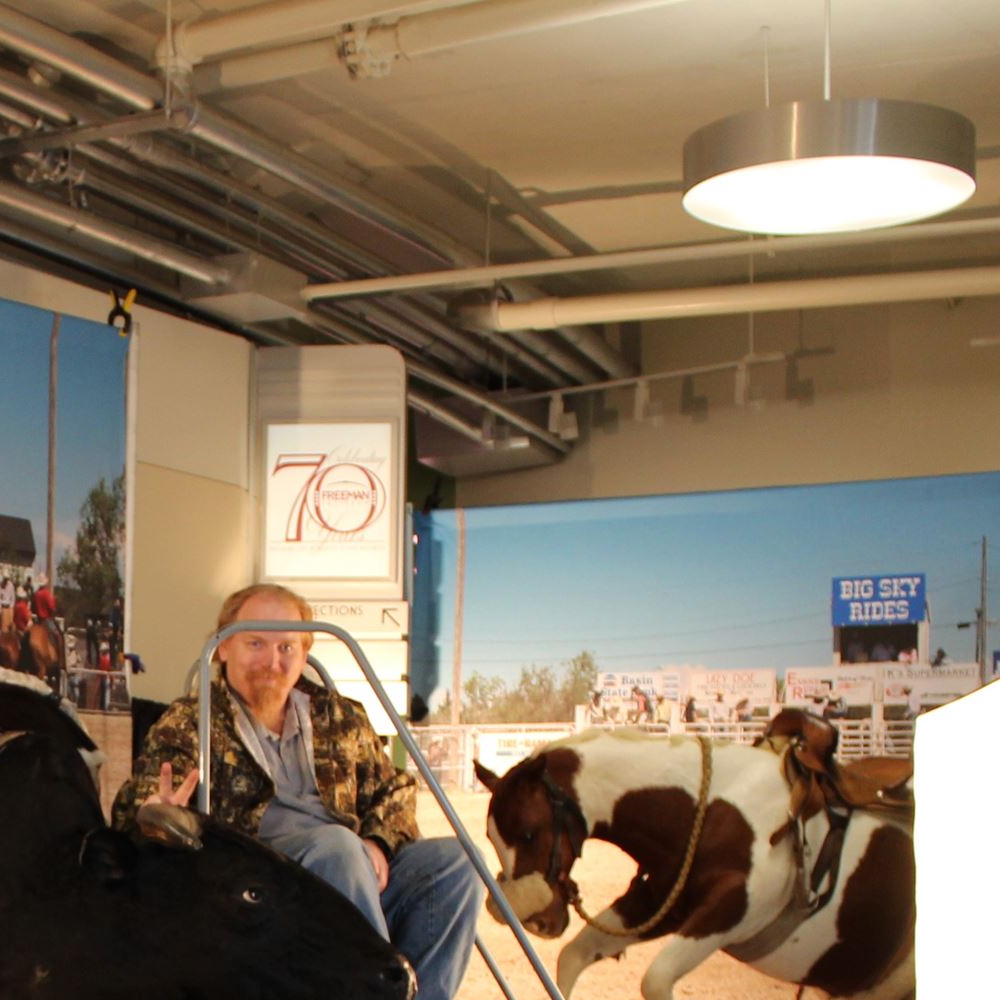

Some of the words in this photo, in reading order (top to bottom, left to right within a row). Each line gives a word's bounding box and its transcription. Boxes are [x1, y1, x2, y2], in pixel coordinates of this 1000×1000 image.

[321, 489, 370, 500] FREEMAN
[839, 579, 874, 599] BIG
[878, 577, 921, 598] SKY
[849, 600, 910, 621] RIDES
